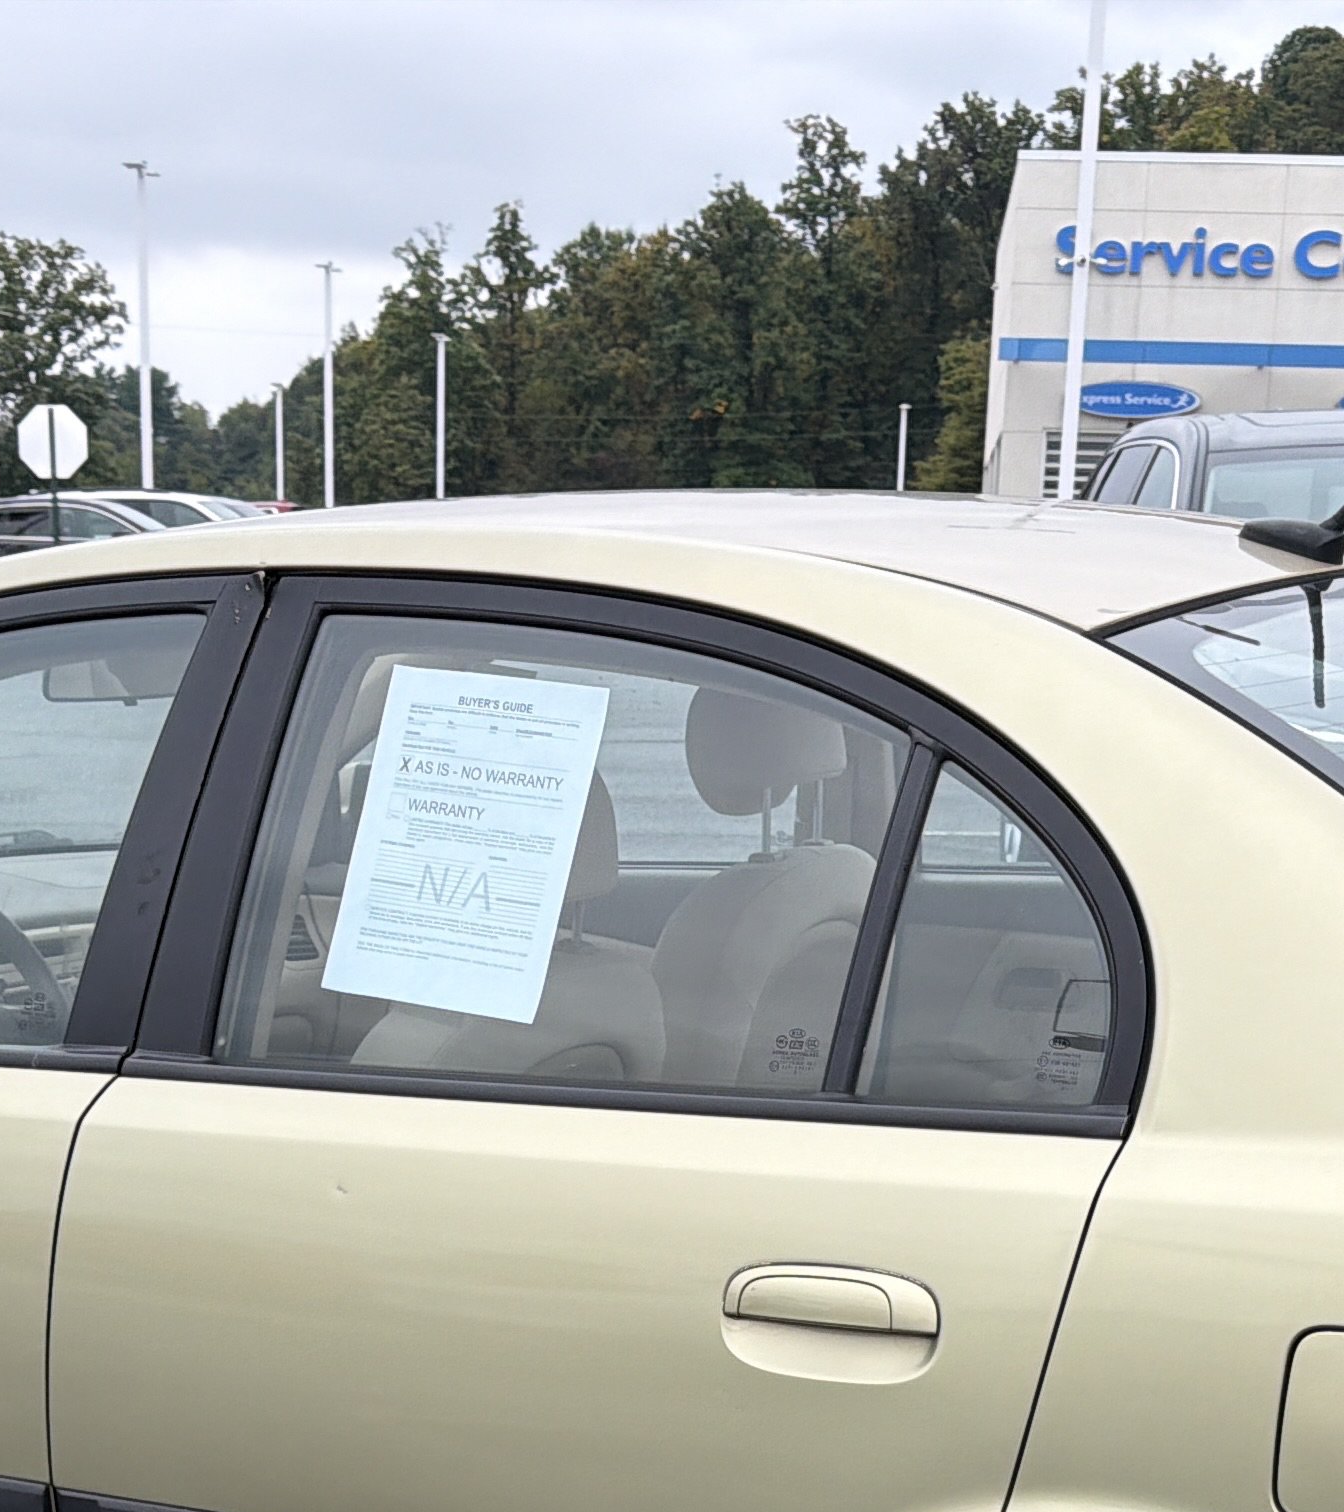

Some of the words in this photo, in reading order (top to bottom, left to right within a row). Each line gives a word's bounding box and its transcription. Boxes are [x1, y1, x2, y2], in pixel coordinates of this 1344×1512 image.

[1082, 395, 1122, 407] xpress
[1124, 393, 1171, 405] Service
[457, 695, 500, 711] BUYER'S
[502, 701, 534, 714] GUIDE
[399, 756, 412, 773] X
[414, 759, 433, 775] AS
[436, 761, 450, 777] IS
[460, 765, 482, 781] NO
[485, 768, 564, 791] WARRANTY
[408, 797, 485, 821] WARRANTY
[416, 862, 492, 913] N/A
